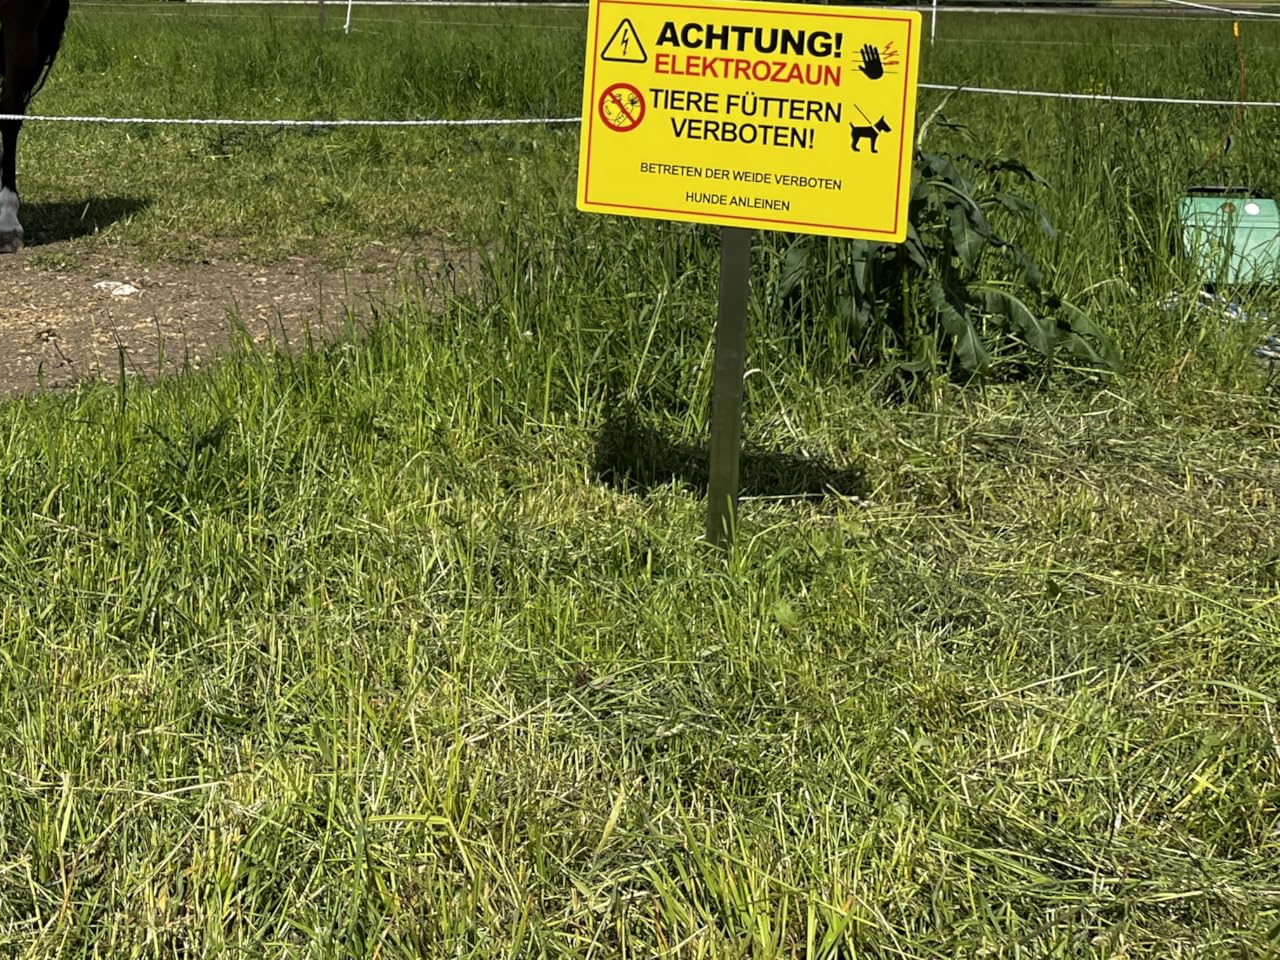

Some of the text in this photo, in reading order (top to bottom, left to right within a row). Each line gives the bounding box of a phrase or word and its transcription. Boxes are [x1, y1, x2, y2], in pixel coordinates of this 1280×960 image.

[655, 21, 843, 58] ACHTUNG!
[654, 53, 842, 87] ELEKTROZAUN
[649, 88, 842, 123] TIERE FÜTTERN
[671, 117, 815, 149] VERBOTEN!
[640, 162, 842, 190] BETRETEN DER WEIDE VERBOTEN
[685, 191, 790, 211] HUNDE ANLEINEN
